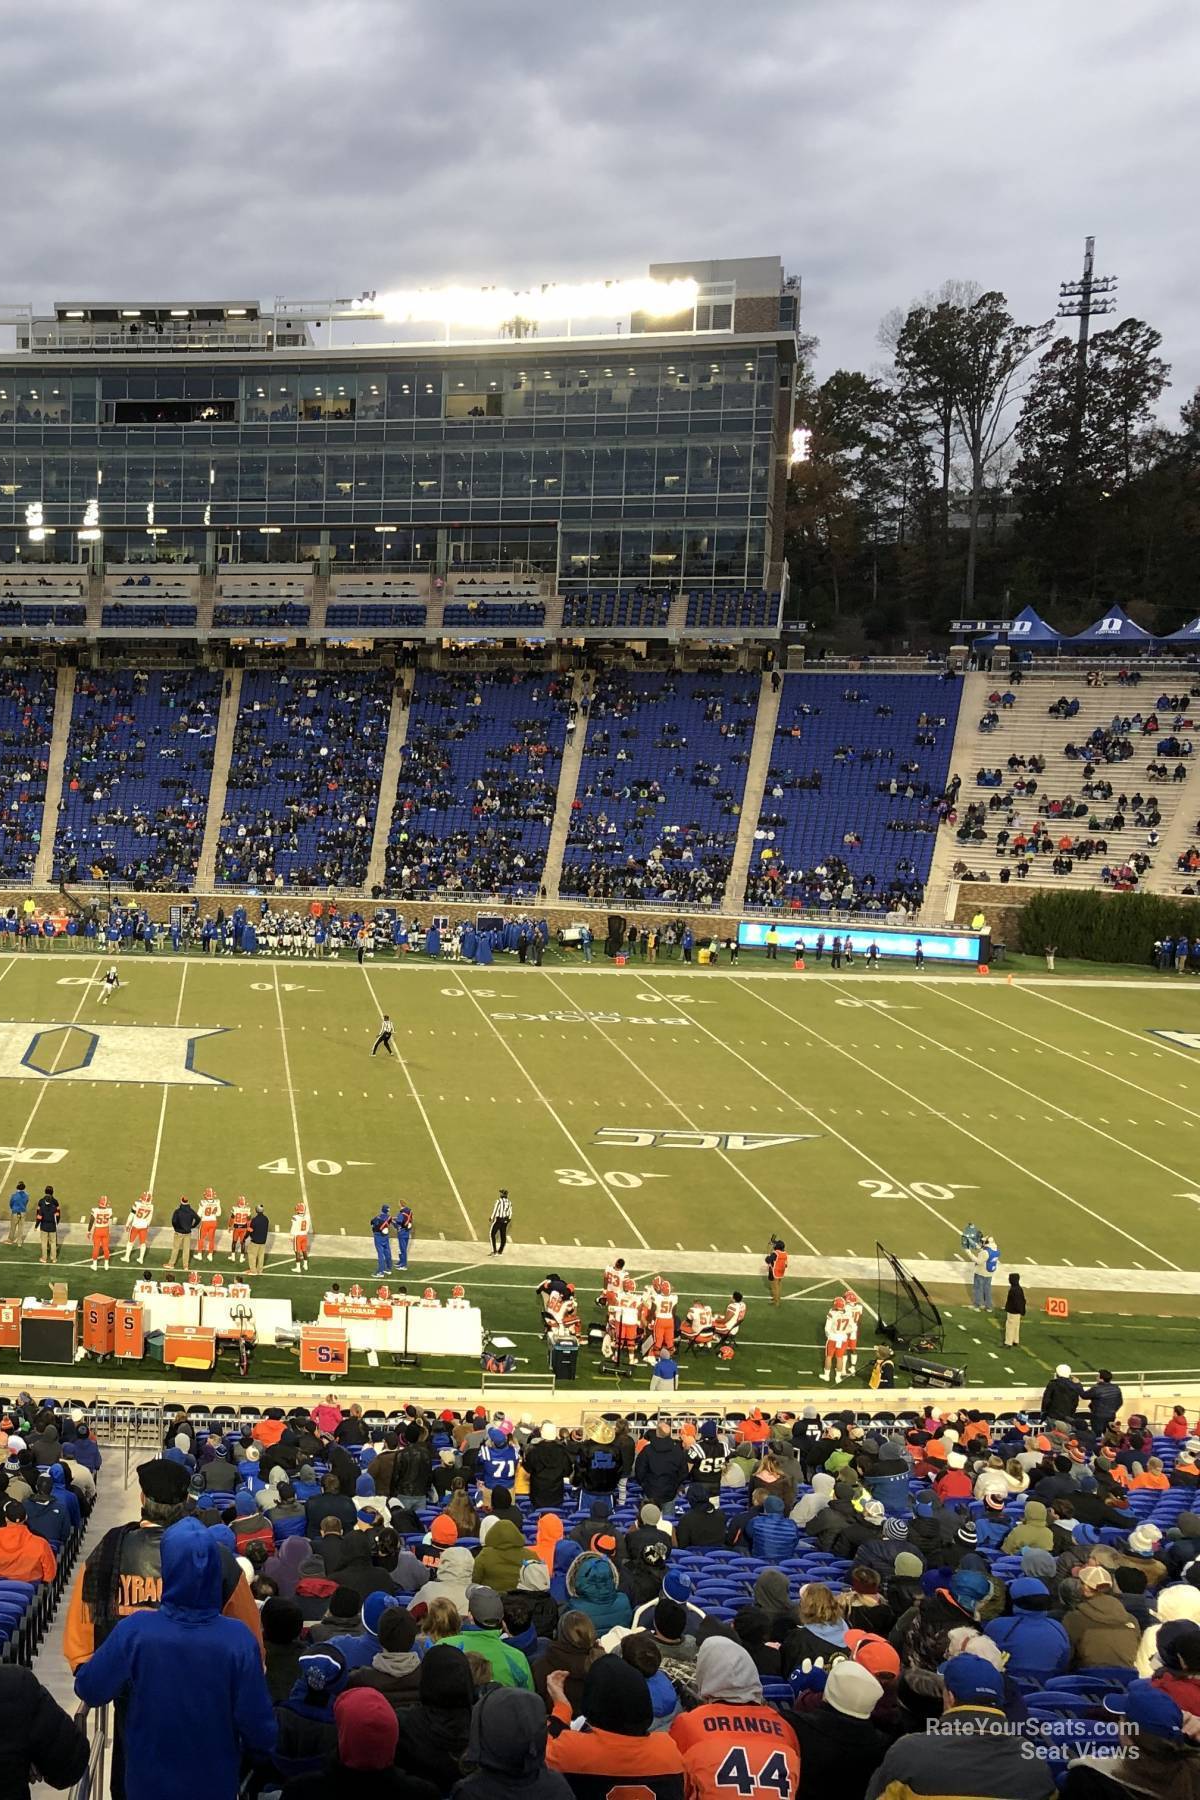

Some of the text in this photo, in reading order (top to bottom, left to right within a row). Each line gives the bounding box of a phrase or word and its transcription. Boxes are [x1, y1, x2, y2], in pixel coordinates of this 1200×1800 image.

[1099, 617, 1123, 631] D
[490, 1012, 693, 1026] BROOKS
[588, 1127, 825, 1151] ACC
[257, 1157, 343, 1176] 40
[554, 1168, 644, 1189] 30
[857, 1179, 956, 1200] 20
[96, 1213, 109, 1224] 55
[136, 1207, 150, 1220] 57
[338, 1306, 377, 1316] GATORADE
[660, 1302, 672, 1314] 51
[1050, 1300, 1066, 1314] 20
[89, 1310, 98, 1324] S
[107, 1311, 115, 1325] S
[124, 1316, 135, 1330] S
[837, 1319, 849, 1332] 17
[316, 1345, 331, 1363] S
[491, 1460, 516, 1478] 71
[119, 1573, 163, 1606] YRA
[703, 1715, 785, 1738] ORANGE
[715, 1745, 792, 1800] 44
